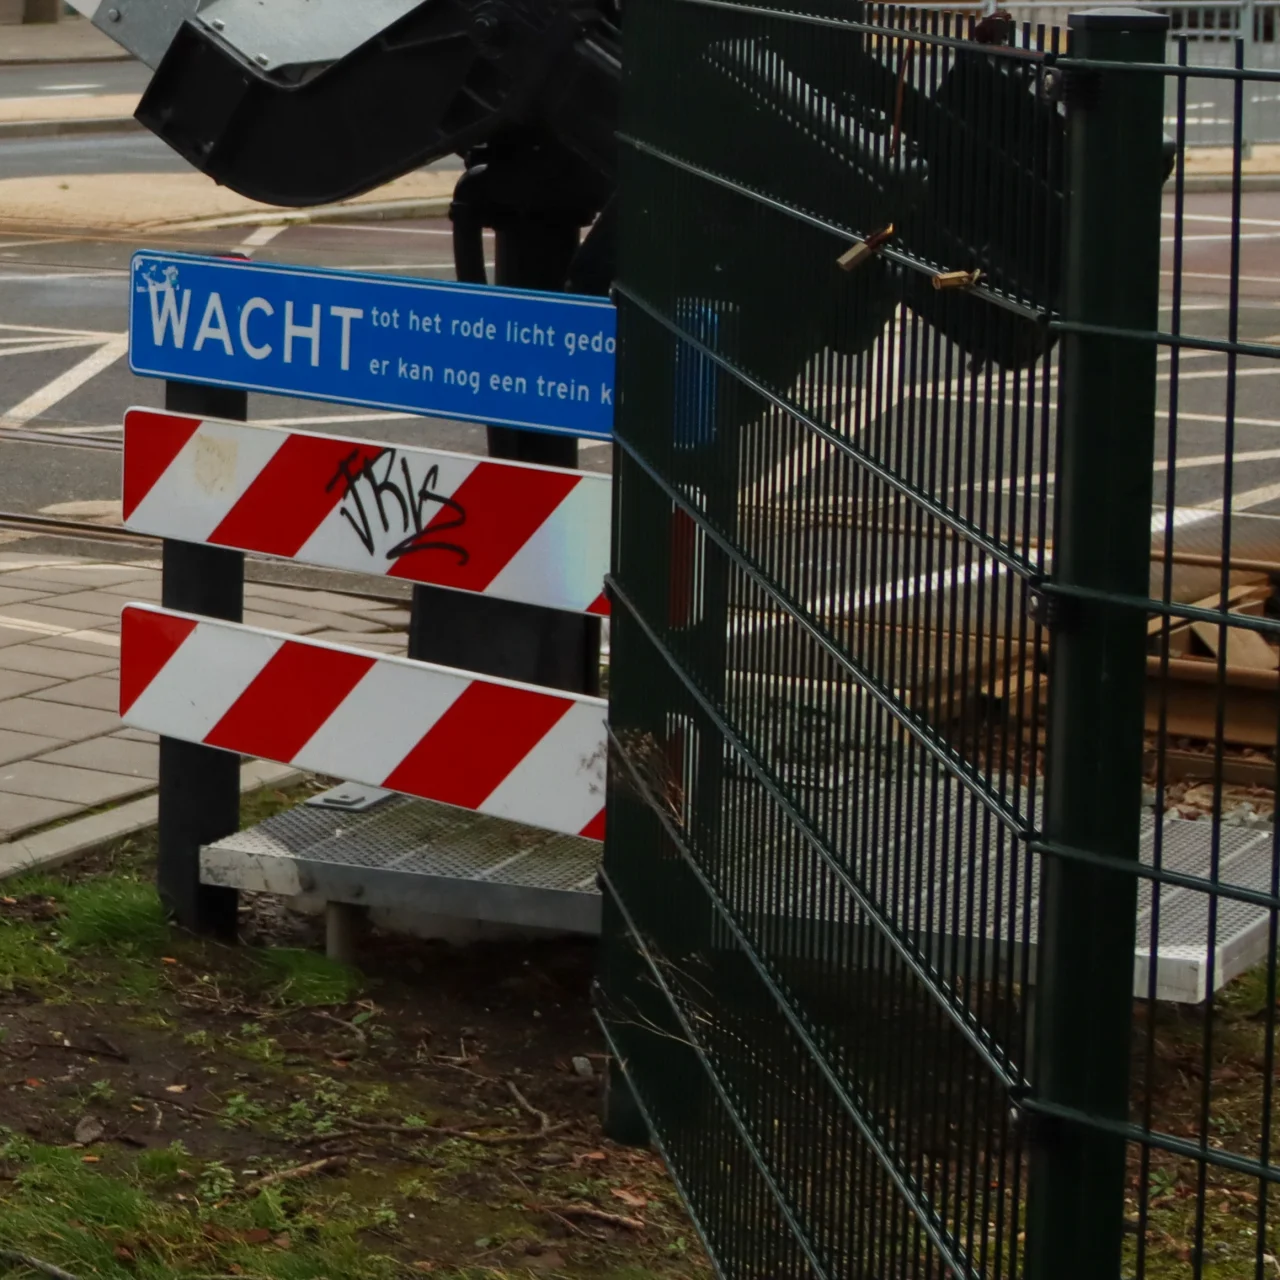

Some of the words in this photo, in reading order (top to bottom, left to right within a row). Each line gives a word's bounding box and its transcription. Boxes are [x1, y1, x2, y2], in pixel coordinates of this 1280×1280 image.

[148, 286, 364, 371] WACHT
[371, 306, 400, 329] tot
[408, 308, 442, 334] het
[451, 313, 497, 341] rode
[506, 320, 555, 347] licht
[564, 330, 617, 356] gedo
[369, 356, 390, 377] er
[398, 356, 434, 383] kan
[443, 367, 480, 395] nog
[489, 372, 527, 395] een
[536, 375, 590, 403] trein
